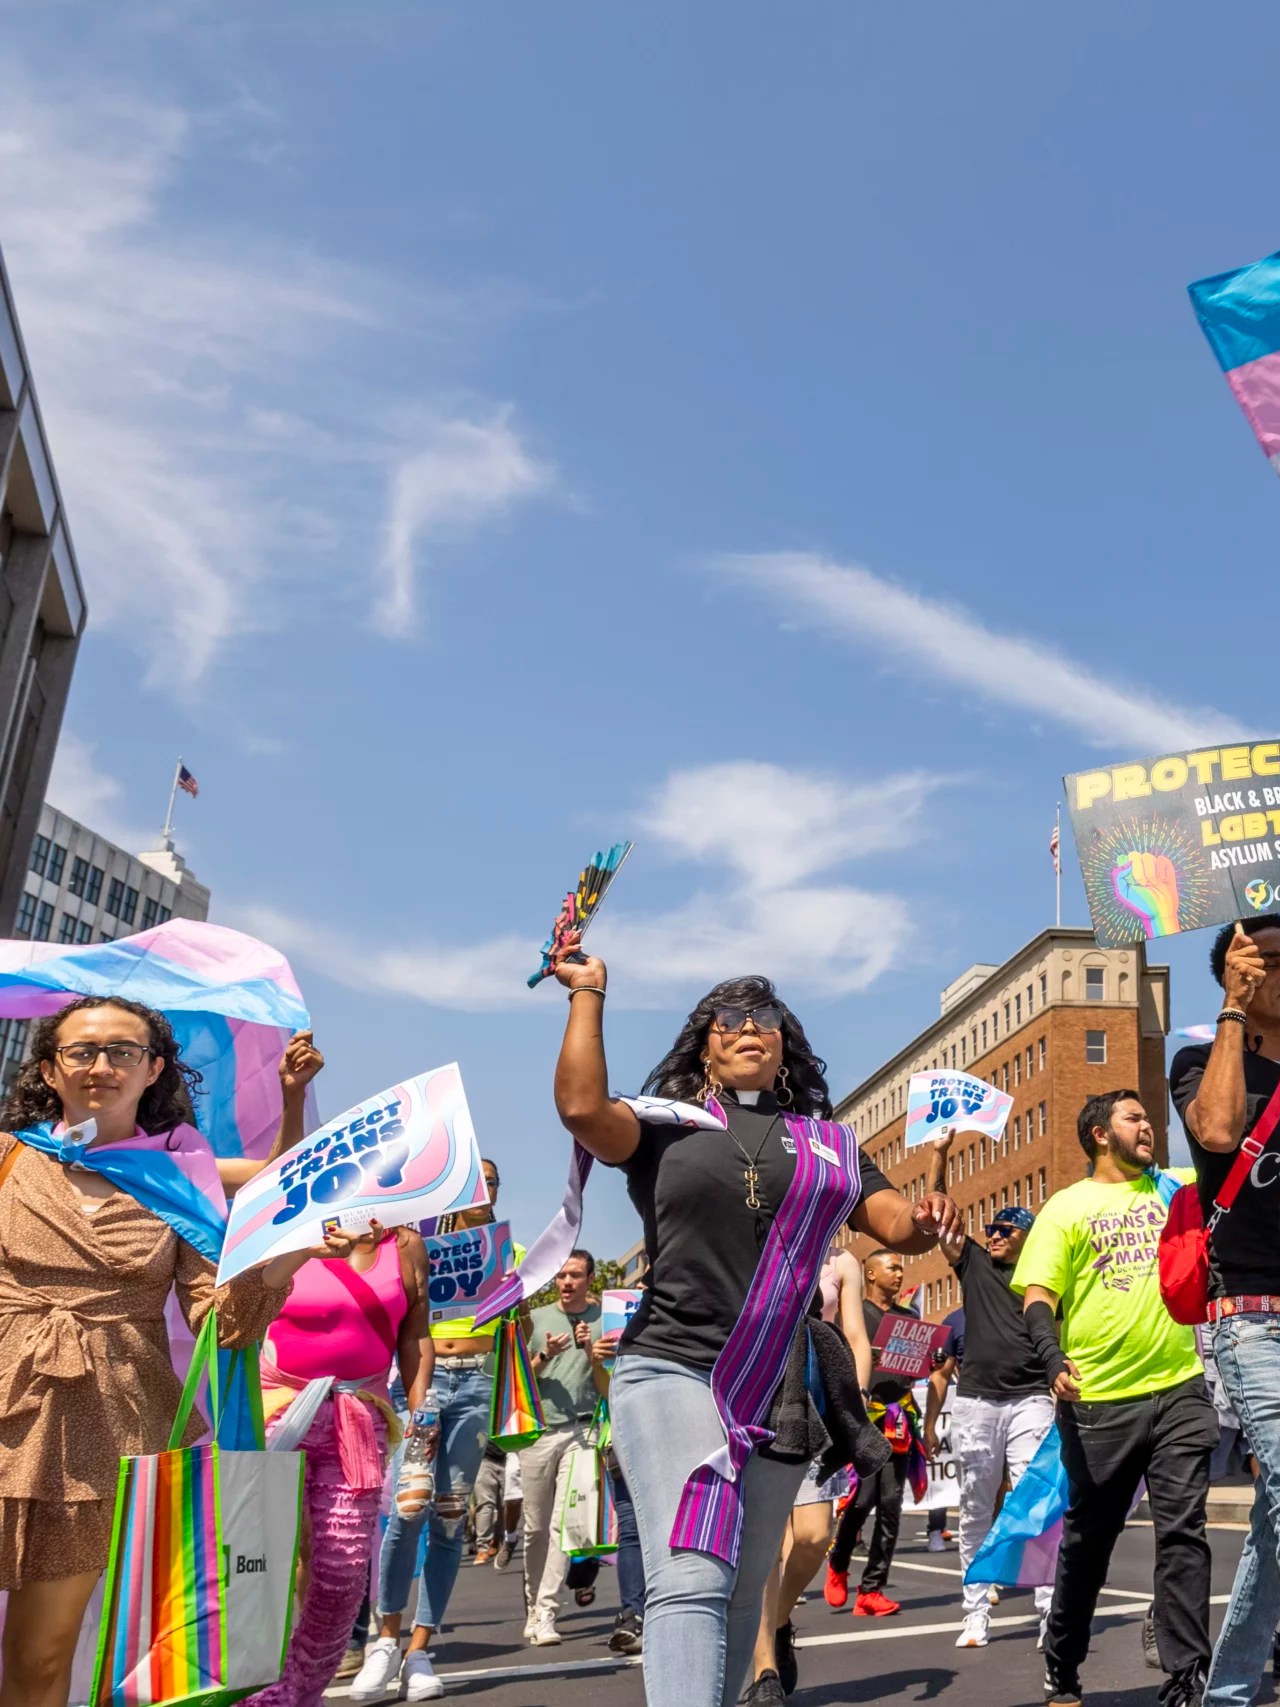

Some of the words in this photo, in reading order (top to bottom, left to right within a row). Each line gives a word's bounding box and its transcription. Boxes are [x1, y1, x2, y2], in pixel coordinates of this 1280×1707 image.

[1194, 791, 1245, 817] BLACK
[1248, 790, 1260, 807] &
[1210, 845, 1273, 870] ASYLUM
[930, 1087, 984, 1102] TRANS
[931, 1078, 988, 1095] PROTECT
[926, 1098, 982, 1123] JOY
[279, 1100, 401, 1177] PROTECT
[278, 1119, 405, 1191] TRANS
[272, 1143, 410, 1225] JOY
[1090, 1214, 1145, 1235] TRANS
[429, 1239, 482, 1260] OTECT
[1115, 1247, 1157, 1265] MAR
[429, 1253, 483, 1277] RANS
[428, 1270, 484, 1303] OY
[891, 1319, 936, 1344] BLACK
[880, 1352, 923, 1374] MATTER
[236, 1553, 267, 1575] Bank
